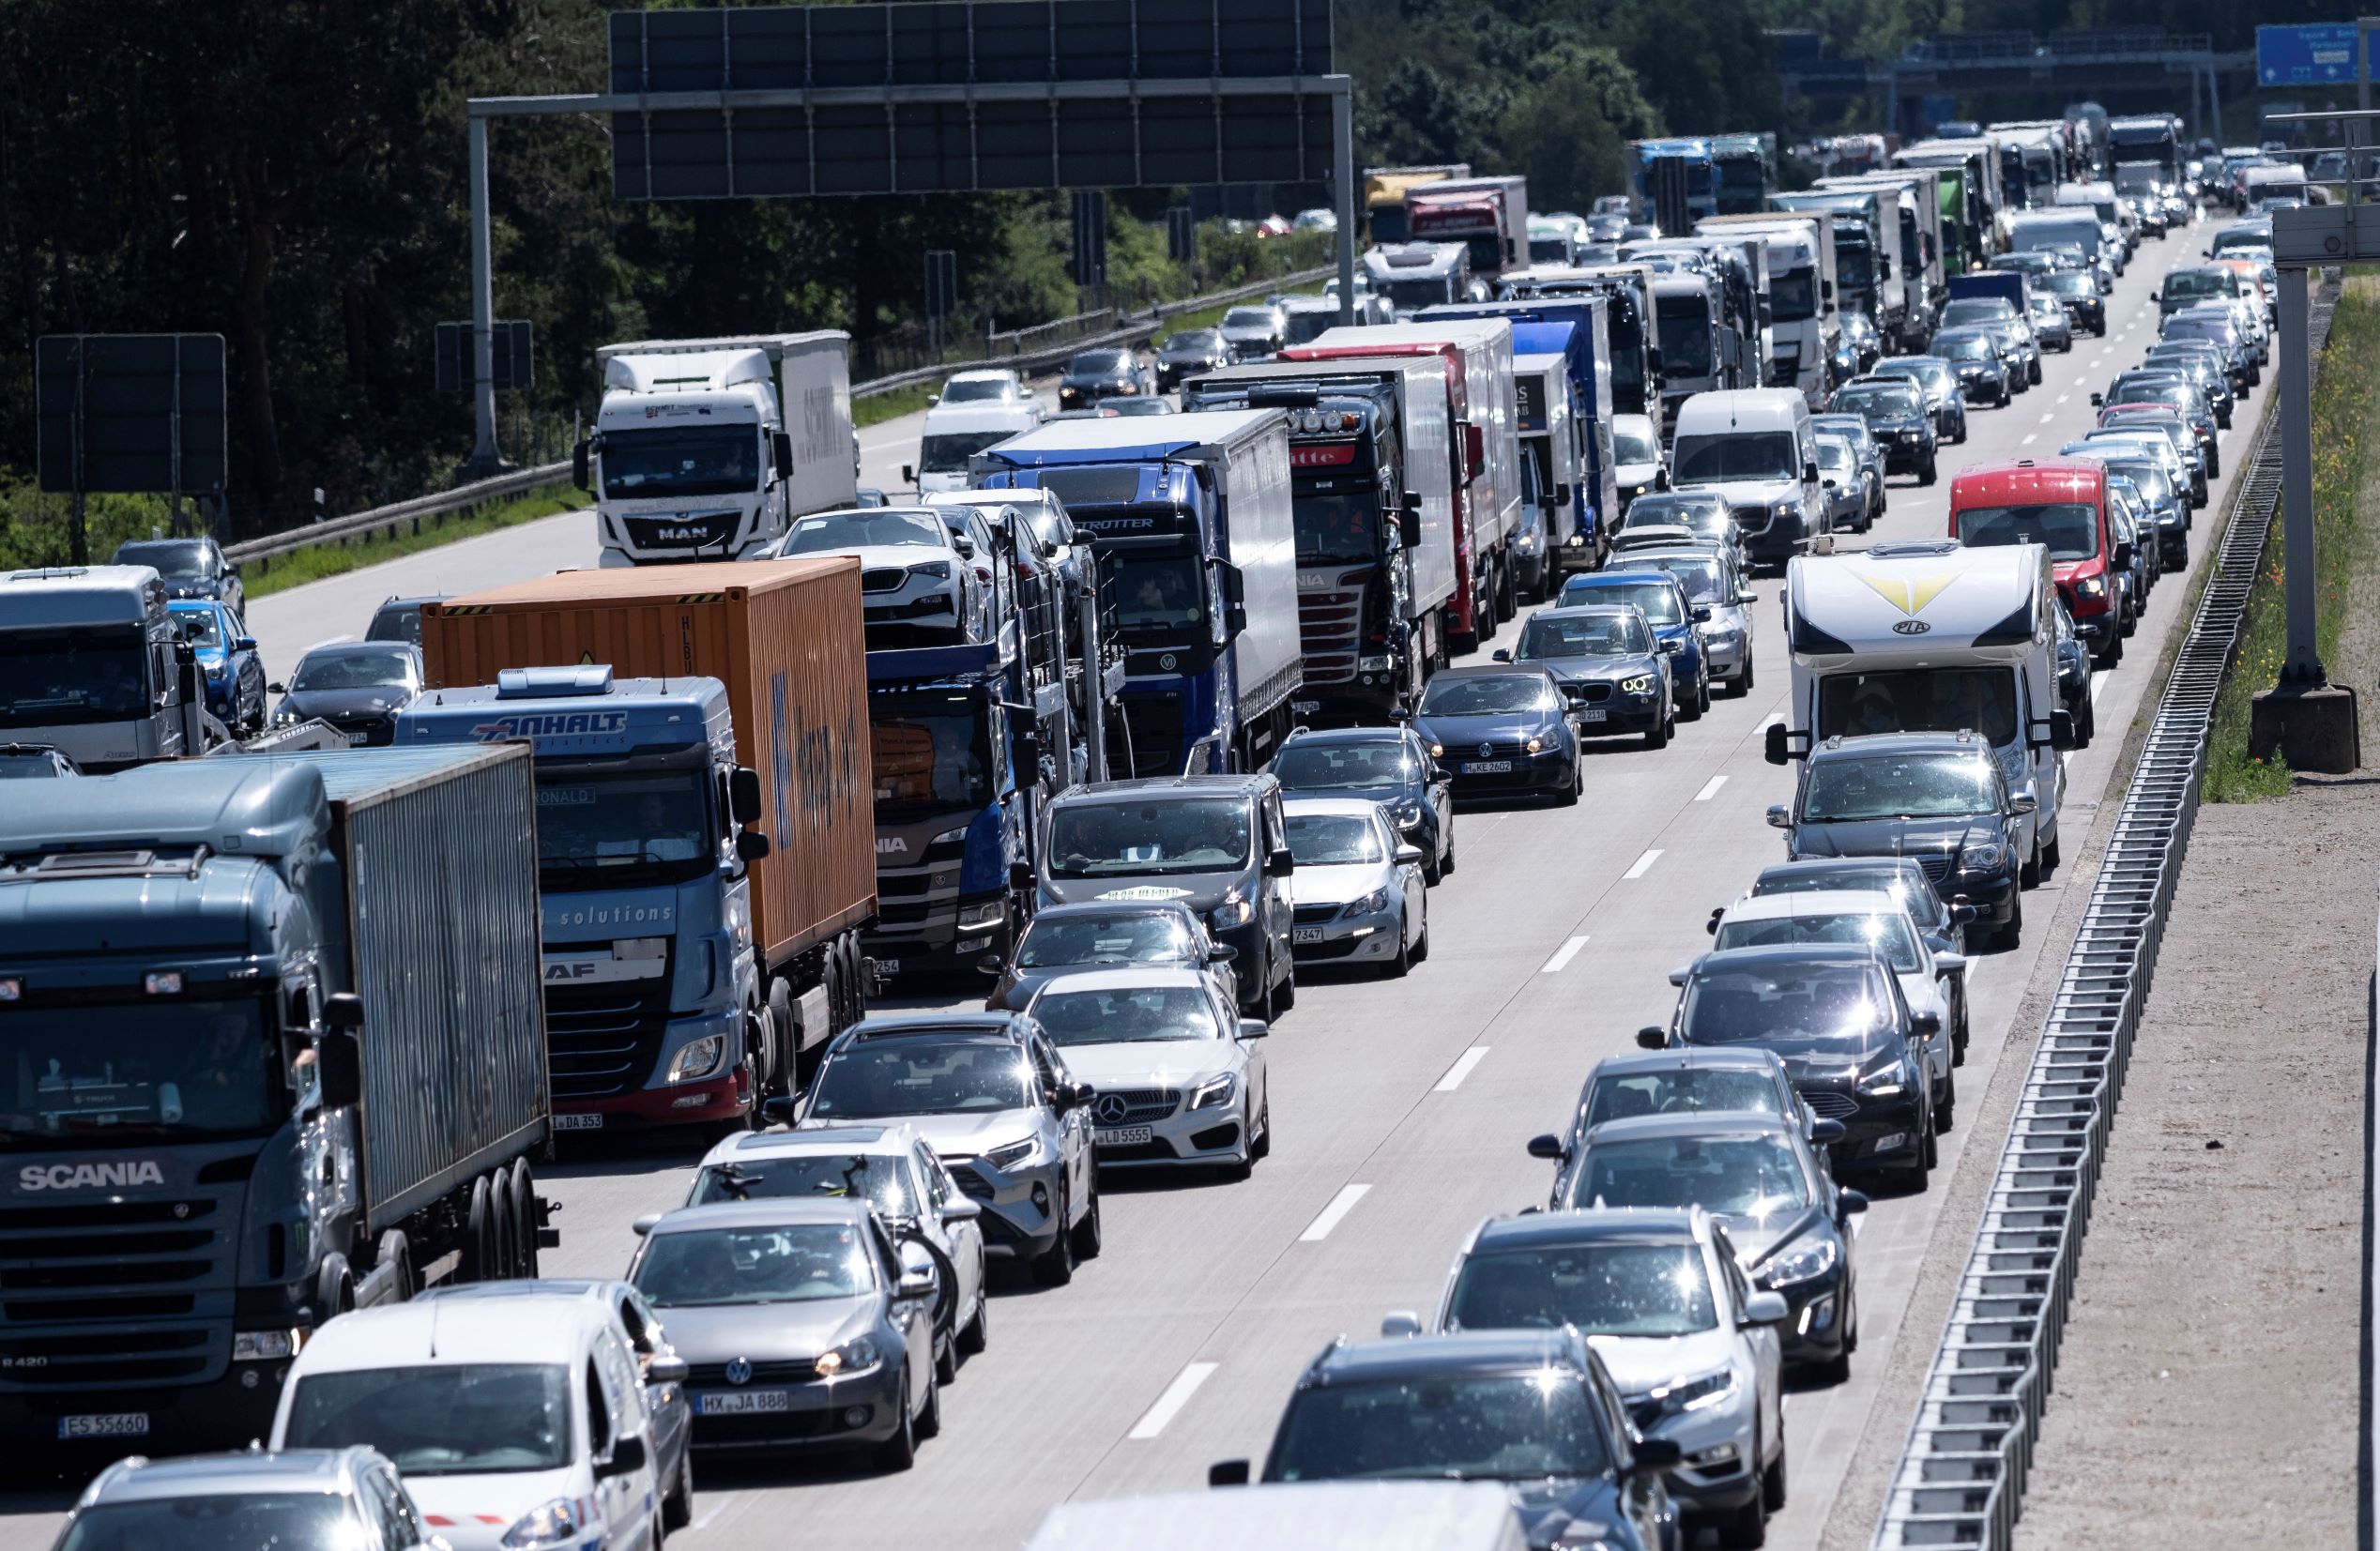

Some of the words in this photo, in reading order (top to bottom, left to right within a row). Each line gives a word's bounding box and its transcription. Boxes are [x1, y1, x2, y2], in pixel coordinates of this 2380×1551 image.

[659, 525, 708, 540] MAN
[1897, 622, 1926, 632] PLA
[681, 616, 692, 675] HLBU
[536, 736, 624, 750] gistics
[560, 905, 672, 925] solutions
[1295, 929, 1320, 940] 7347
[544, 963, 595, 980] AF
[582, 1115, 601, 1127] 353
[1121, 1129, 1148, 1142] 5555
[20, 1162, 164, 1191] SCANIA
[15, 1356, 48, 1367] 420
[705, 1395, 724, 1411] HX
[736, 1394, 755, 1409] JA
[757, 1392, 786, 1408] 888
[68, 1417, 90, 1434] ES
[96, 1415, 145, 1433] 55660
